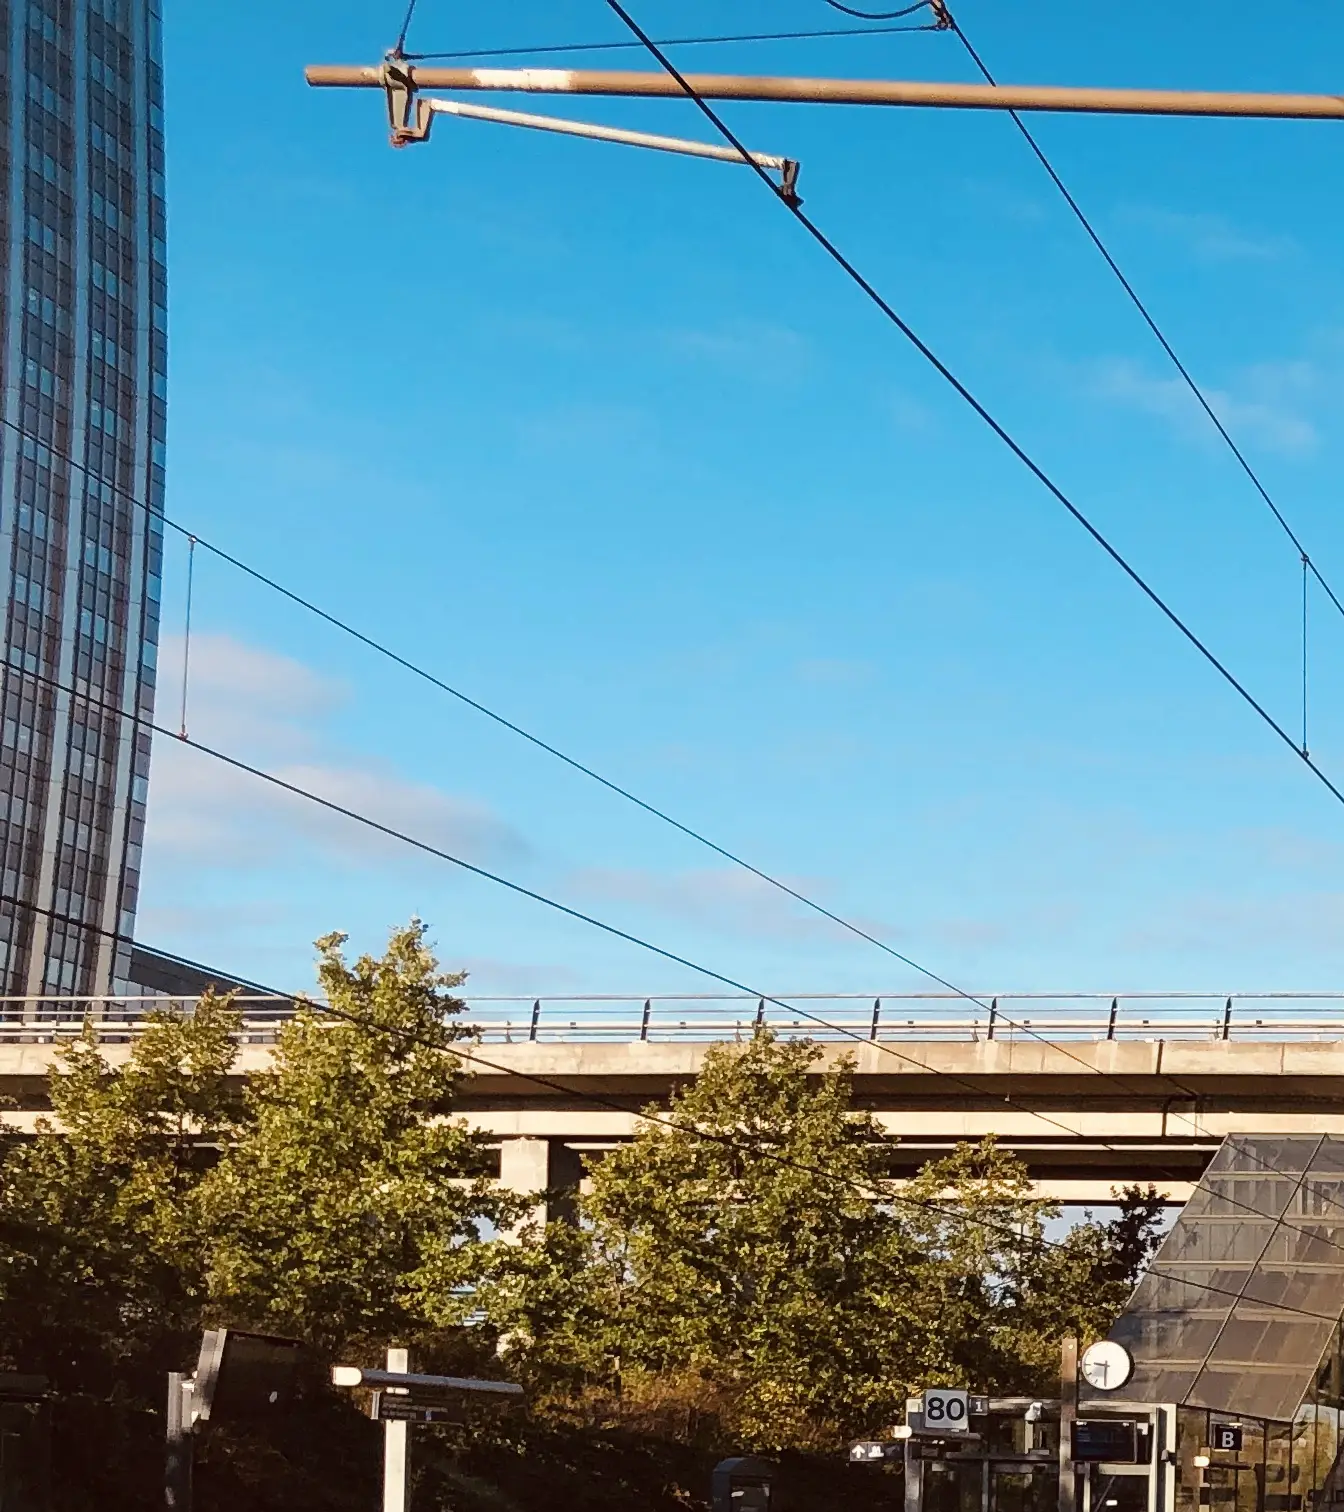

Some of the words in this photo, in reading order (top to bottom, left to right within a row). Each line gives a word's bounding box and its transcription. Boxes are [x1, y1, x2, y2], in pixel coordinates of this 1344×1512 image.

[927, 1396, 965, 1421] 80
[975, 1401, 983, 1412] 1
[1221, 1431, 1235, 1448] B
